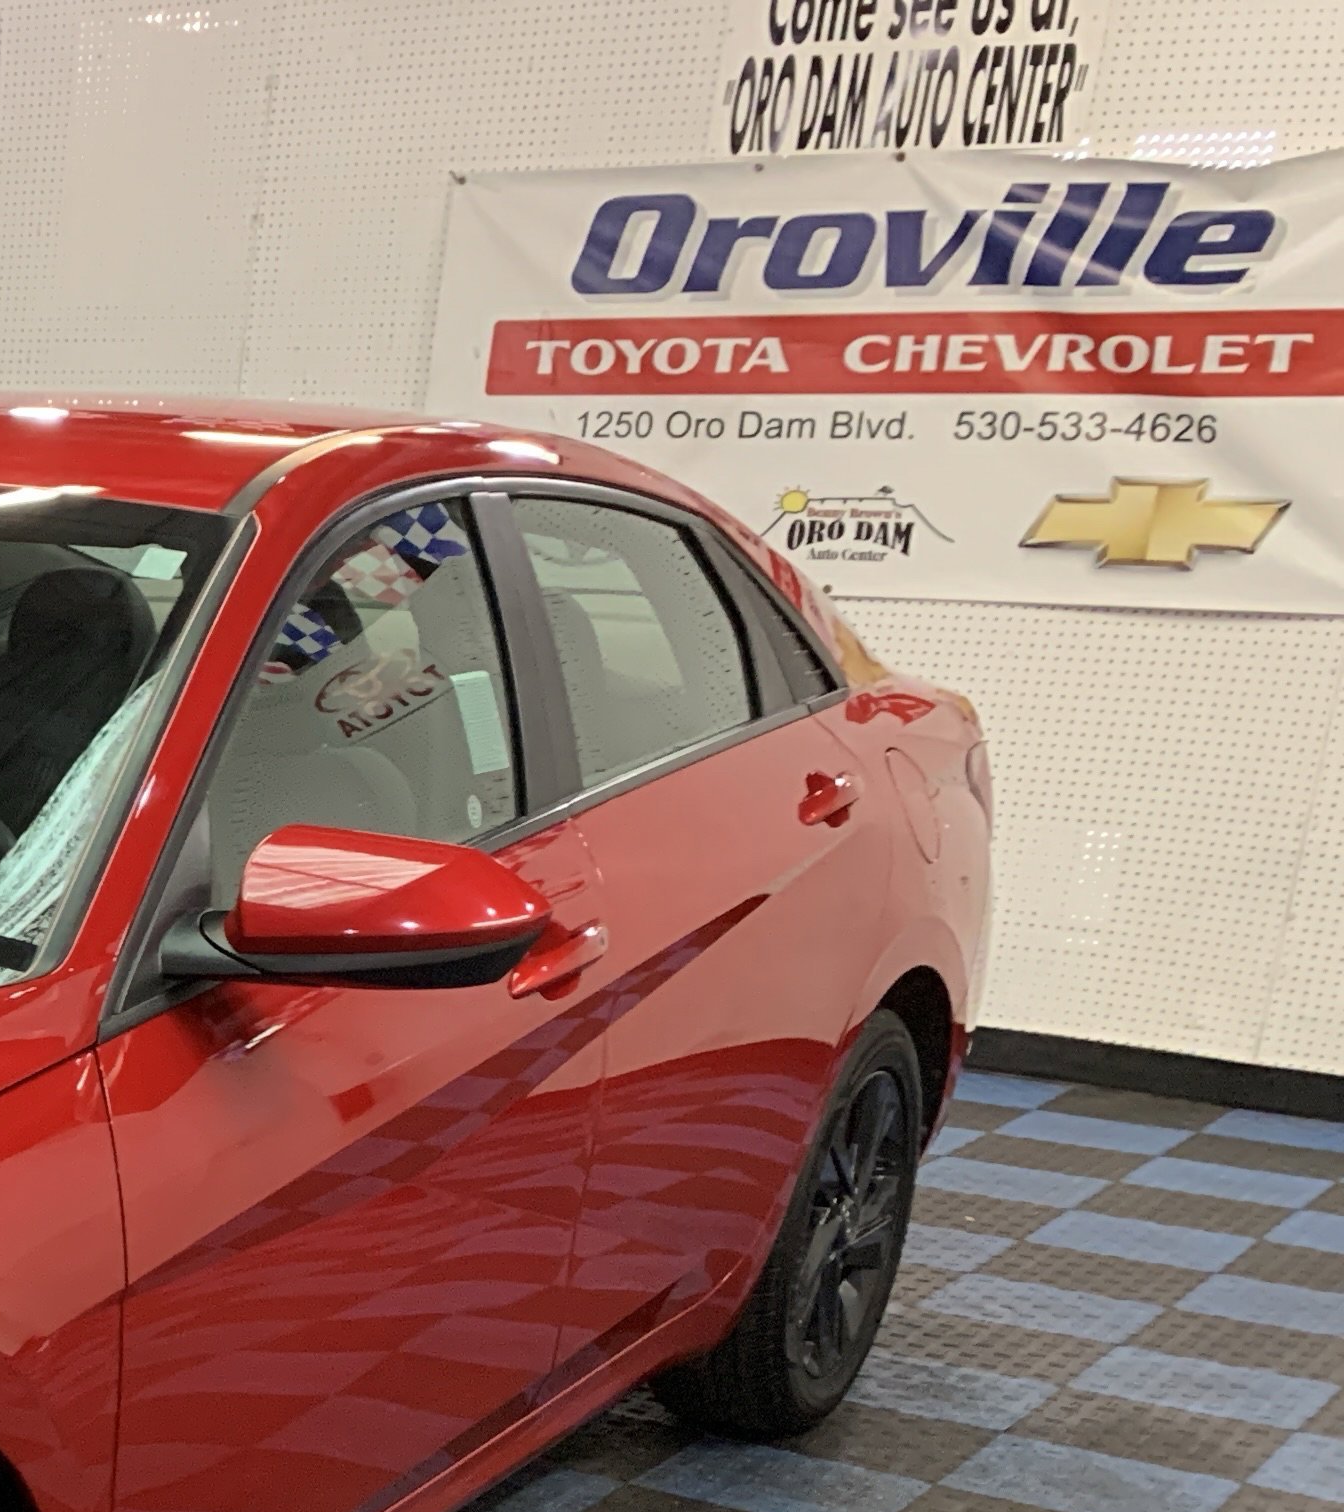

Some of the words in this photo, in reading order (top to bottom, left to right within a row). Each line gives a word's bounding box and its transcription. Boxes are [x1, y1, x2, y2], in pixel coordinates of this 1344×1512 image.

[723, 54, 796, 154] "ORO
[796, 52, 874, 151] DAM
[868, 45, 961, 149] AUTO
[963, 43, 1089, 147] CENTER"
[569, 181, 1279, 297] Oroville
[525, 336, 789, 377] TOYOTA
[843, 332, 1315, 377] CHEVROLET
[576, 411, 654, 440] 1250
[665, 411, 726, 440] Oro
[738, 411, 816, 440] Dam
[830, 410, 916, 440] Blvd.
[953, 410, 1219, 444] 530-533-4626
[787, 519, 845, 551] ORO
[853, 521, 914, 555] DAM
[807, 548, 838, 561] Auto
[842, 549, 888, 562] Center
